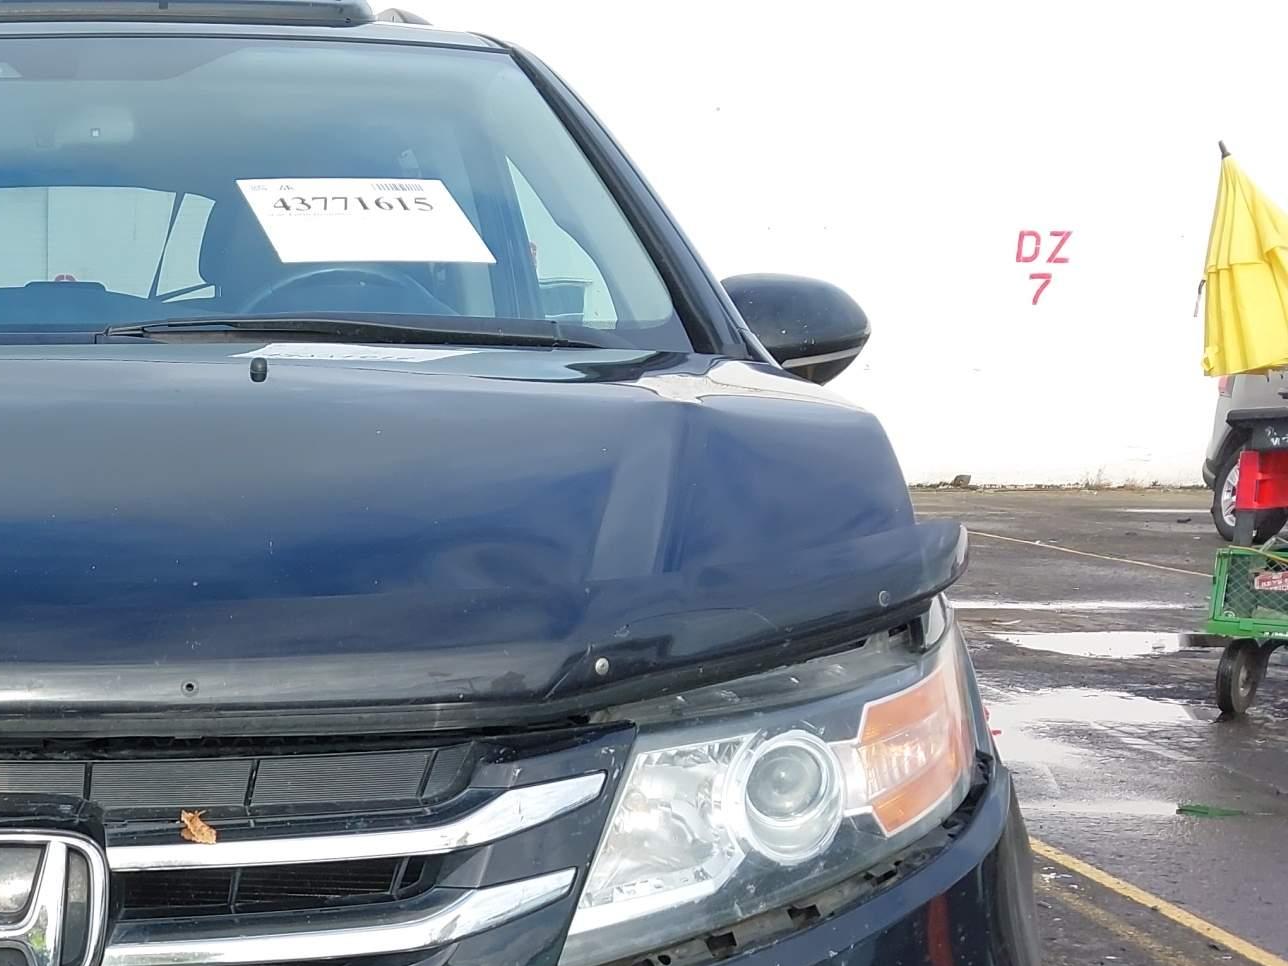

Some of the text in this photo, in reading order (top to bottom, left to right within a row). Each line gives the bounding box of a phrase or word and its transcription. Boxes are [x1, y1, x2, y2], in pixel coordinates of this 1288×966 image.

[272, 196, 434, 213] 43771615
[1015, 229, 1073, 264] DZ
[1029, 272, 1052, 306] 7
